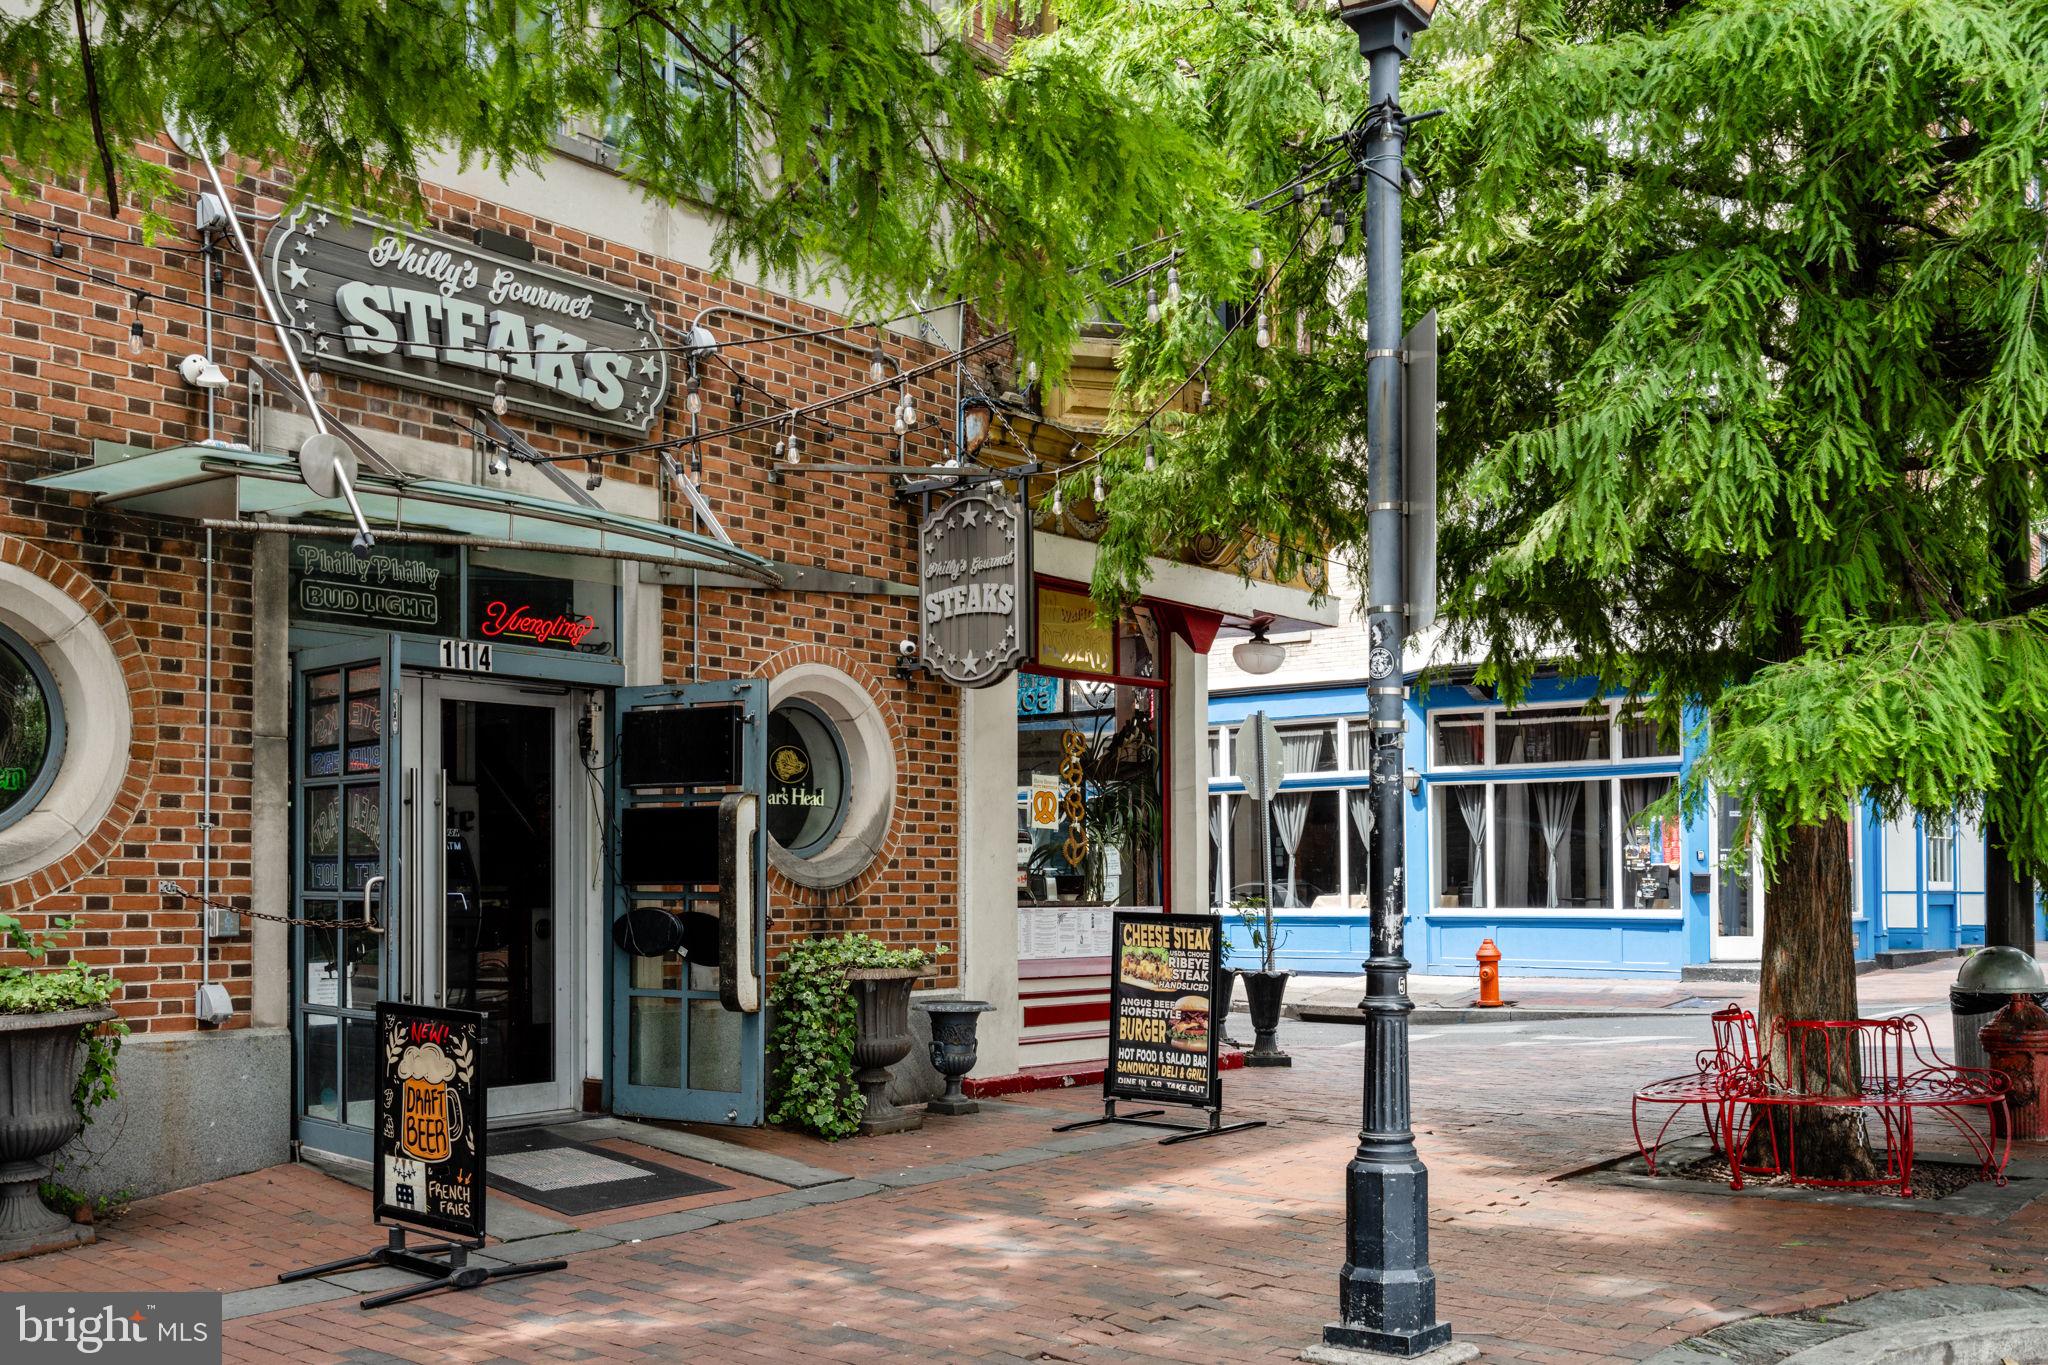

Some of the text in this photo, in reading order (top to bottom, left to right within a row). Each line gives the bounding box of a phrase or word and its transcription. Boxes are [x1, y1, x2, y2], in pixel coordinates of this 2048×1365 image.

[368, 236, 594, 320] Philly's Gourmet
[336, 280, 633, 412] STEAKS
[297, 544, 440, 590] Philly Philly
[925, 549, 1015, 581] Philly's Gourmet
[305, 585, 435, 619] BUD LIGHT
[925, 582, 1015, 624] STEAKS
[481, 601, 595, 646] Yuengling
[442, 640, 491, 671] 114
[791, 786, 825, 807] Head
[1123, 923, 1170, 948] CHEESE
[1173, 926, 1211, 950] STEAK
[1168, 957, 1209, 970] RIBEYE
[1187, 951, 1210, 959] CHOICE
[1158, 981, 1209, 991] HANDSLICED
[1172, 969, 1209, 982] STEAK
[1120, 998, 1176, 1009] ANGUS BEEF
[1121, 1006, 1182, 1019] HOMESTYLE
[410, 1021, 449, 1044] NEW!
[1119, 1017, 1167, 1043] BURGER
[1118, 1047, 1207, 1068] HOT FOOD & SALAD BAR
[1117, 1061, 1207, 1081] SANDWICH DELI & GRILL
[1117, 1077, 1205, 1093] DINE IN OR TAKE OUT
[406, 1086, 446, 1117] DRAFT
[406, 1115, 447, 1154] BEER
[428, 1180, 471, 1203] FRENCH
[439, 1200, 471, 1218] FRIES
